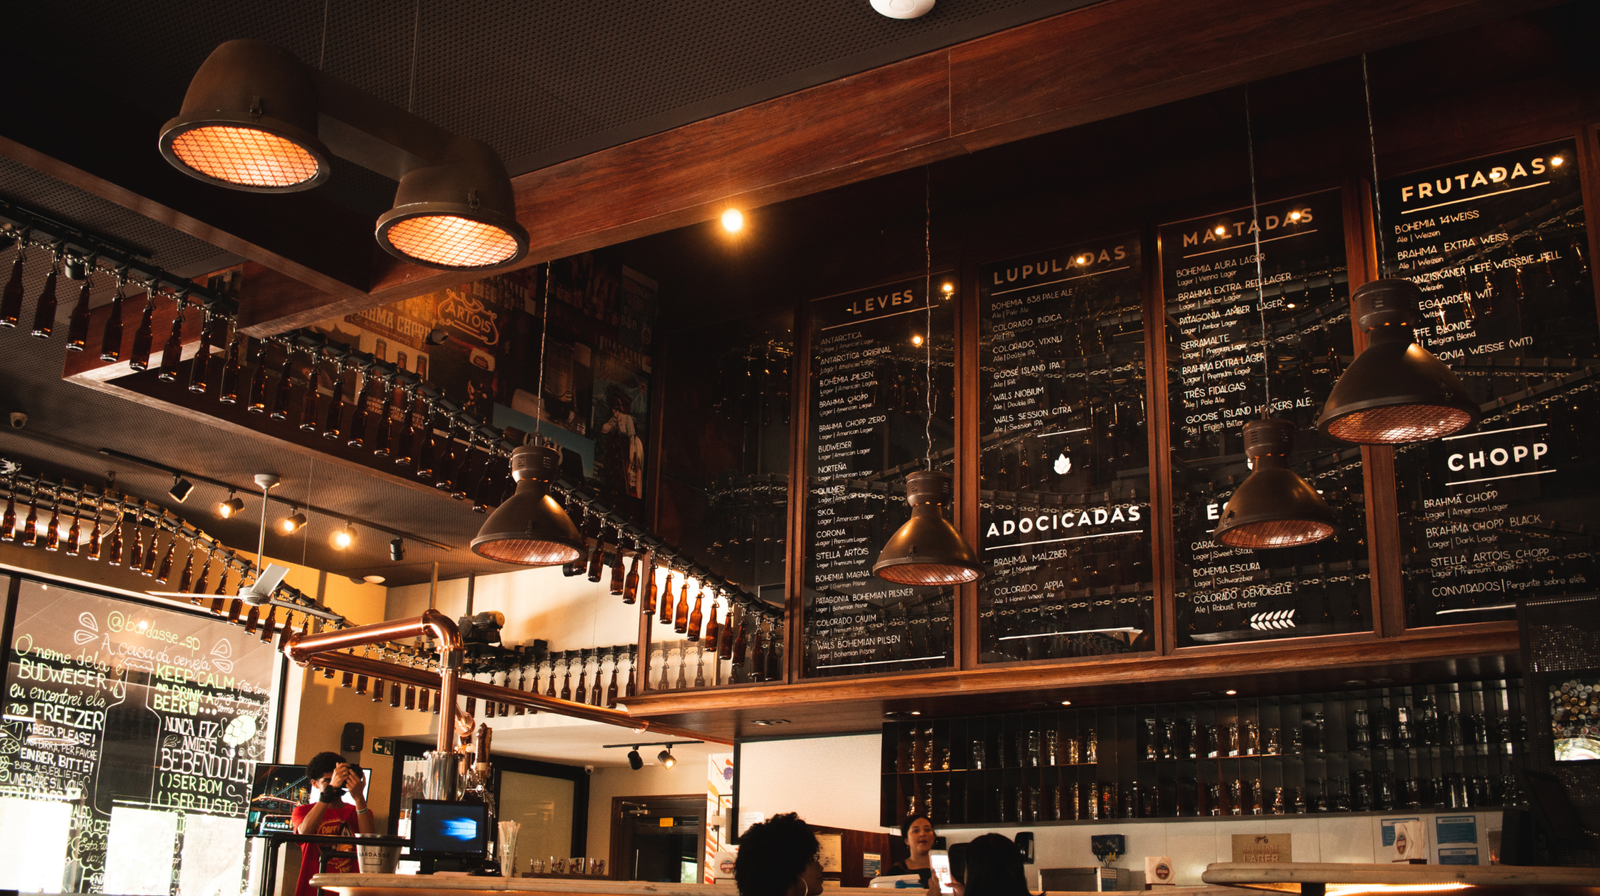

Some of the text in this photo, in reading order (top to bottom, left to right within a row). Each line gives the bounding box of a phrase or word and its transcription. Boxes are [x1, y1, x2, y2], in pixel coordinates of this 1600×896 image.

[1402, 158, 1546, 202] FRUTADAS
[1394, 218, 1436, 234] BOHEMIA
[1398, 232, 1509, 261] BRAHMA EXTRA WEISS
[994, 246, 1126, 285] LUPULADAS
[1176, 252, 1266, 278] BOHEMIA AURA LAGR
[1470, 262, 1491, 274] HEFE
[1540, 250, 1562, 262] HELL
[1042, 291, 1059, 300] PALE
[1060, 288, 1072, 297] ALE
[1178, 288, 1212, 302] BRAHMA
[1214, 282, 1242, 294] EXTRA
[1264, 272, 1292, 284] LAGER
[853, 290, 914, 315] LEVES
[1418, 287, 1494, 310] EGAARDEN WIT
[445, 300, 491, 333] ARTOIS
[992, 313, 1062, 332] COLORADO INDICA
[1179, 311, 1220, 325] PATAGONIA
[820, 331, 862, 346] ANTARCTICA
[992, 340, 1034, 354] COLORADO
[1180, 333, 1230, 350] SERRAMALTE
[1468, 336, 1534, 356] WEISSE (WIT)
[820, 346, 892, 366] ANTARCTICA ORIGINAL
[994, 361, 1060, 380] GOOSE ISLAND IPA
[1182, 362, 1214, 375] BRAHMA
[1215, 358, 1240, 370] EXTRA
[820, 371, 874, 388] BOHEMIA PILSEN
[992, 392, 1012, 402] WALS
[1184, 382, 1246, 400] TRÊS FIDALGAS
[819, 394, 869, 408] BRAHMA CHOPP
[1186, 411, 1218, 424] GOOSE
[1223, 406, 1252, 418] ISLAND
[1296, 396, 1311, 408] ALE
[819, 414, 886, 432] BRAHMA CHOPP ZERO
[994, 406, 1072, 424] WALS SESSION CITRA
[818, 441, 852, 452] BUDWEISER
[1447, 442, 1548, 472] CHOPP
[818, 462, 847, 474] NORTEÑA
[818, 484, 846, 495] QUILMES
[1424, 490, 1498, 509] BRAHMA CHOPP
[818, 508, 835, 516] SKOL
[986, 506, 1141, 538] ADOCICADAS
[1426, 514, 1542, 538] BRAHMA CHOPP BLACK
[816, 528, 846, 538] CORONA
[816, 548, 870, 560] STELLA ARTOIS
[1191, 540, 1223, 550] CARAC
[994, 549, 1068, 567] BRAHMA MALZBIER
[1430, 548, 1550, 568] STELLA ARTOIS CHOPP
[815, 570, 870, 583] BOHEMIA MAGNA
[1192, 562, 1260, 578] BOHEMIA ESCURA
[994, 580, 1064, 596] COLORADO APPIA
[1544, 576, 1566, 586] sobre
[816, 588, 914, 605] PATAGONIA BOHEMIAN PILSNER
[1194, 586, 1292, 604] COLORADO DEMOISELLE
[816, 616, 852, 627] COLORADO
[816, 634, 900, 650] WALS BOHEMIAN PILSEN
[34, 646, 72, 664] nome
[76, 648, 110, 672] dela
[119, 642, 155, 660] casa
[156, 646, 170, 664] da
[156, 663, 235, 692] KEEP CALM
[10, 683, 106, 708] eu encontrei ela
[172, 685, 203, 704] DRINK
[154, 694, 188, 714] BEER
[10, 702, 104, 730] no FREEZER
[164, 716, 195, 736] NUNCA
[182, 736, 218, 757] AMIGOS
[198, 777, 222, 796] BOM
